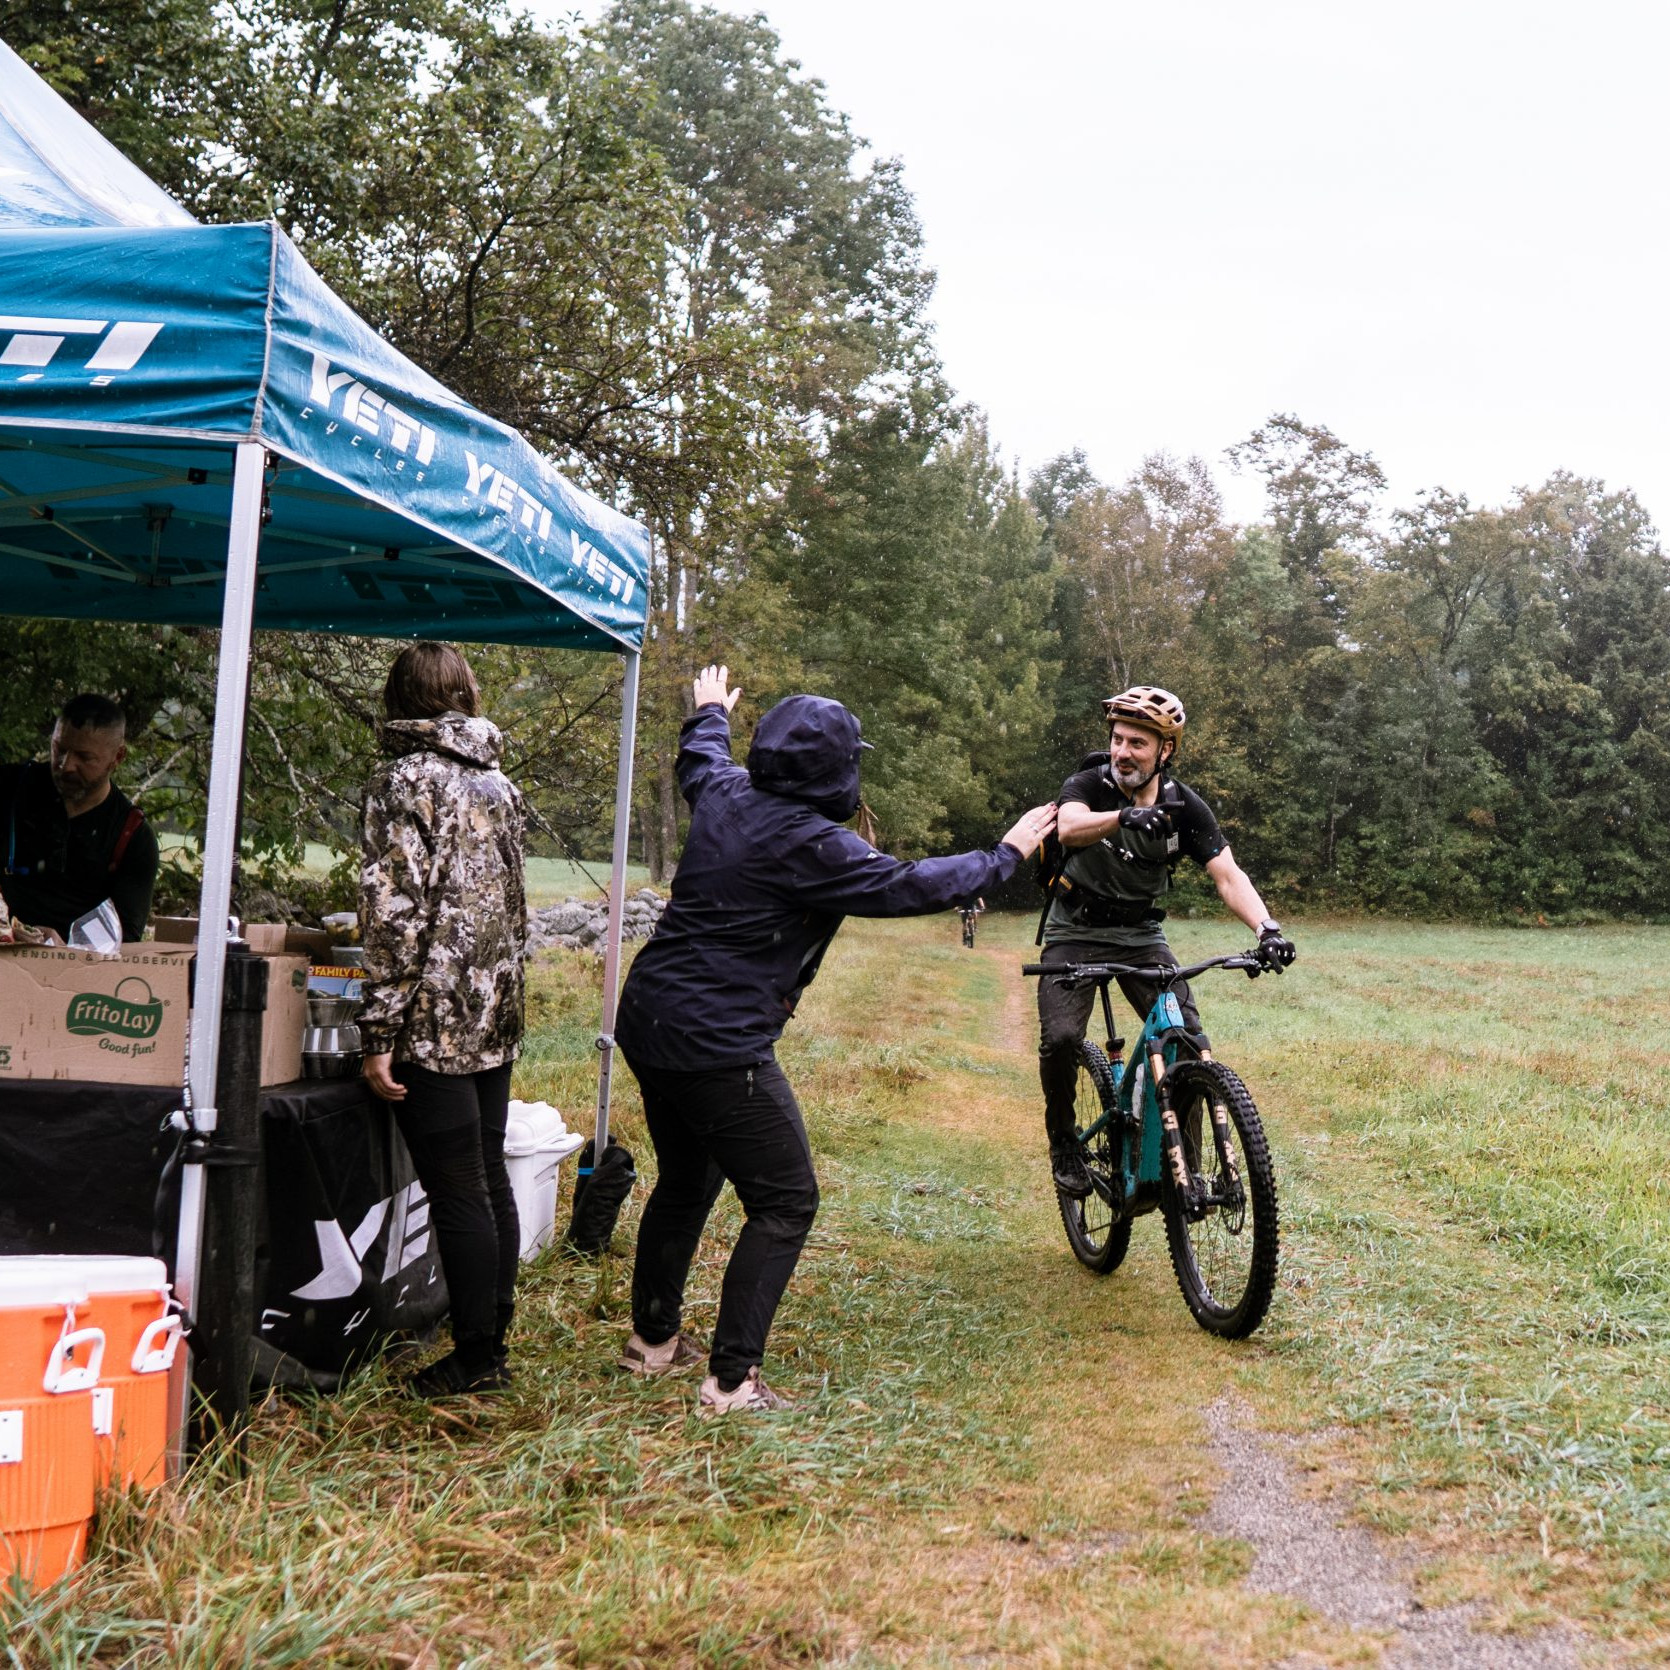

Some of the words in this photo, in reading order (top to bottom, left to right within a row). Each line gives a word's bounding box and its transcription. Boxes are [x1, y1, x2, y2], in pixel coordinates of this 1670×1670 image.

[310, 353, 436, 467] YETI
[464, 450, 553, 541] YETI
[570, 529, 637, 605] YETI
[12, 949, 76, 961] VENDING
[86, 953, 94, 962] &
[314, 966, 350, 978] FAMILY
[98, 1038, 130, 1055] Good
[131, 1041, 156, 1058] fun!
